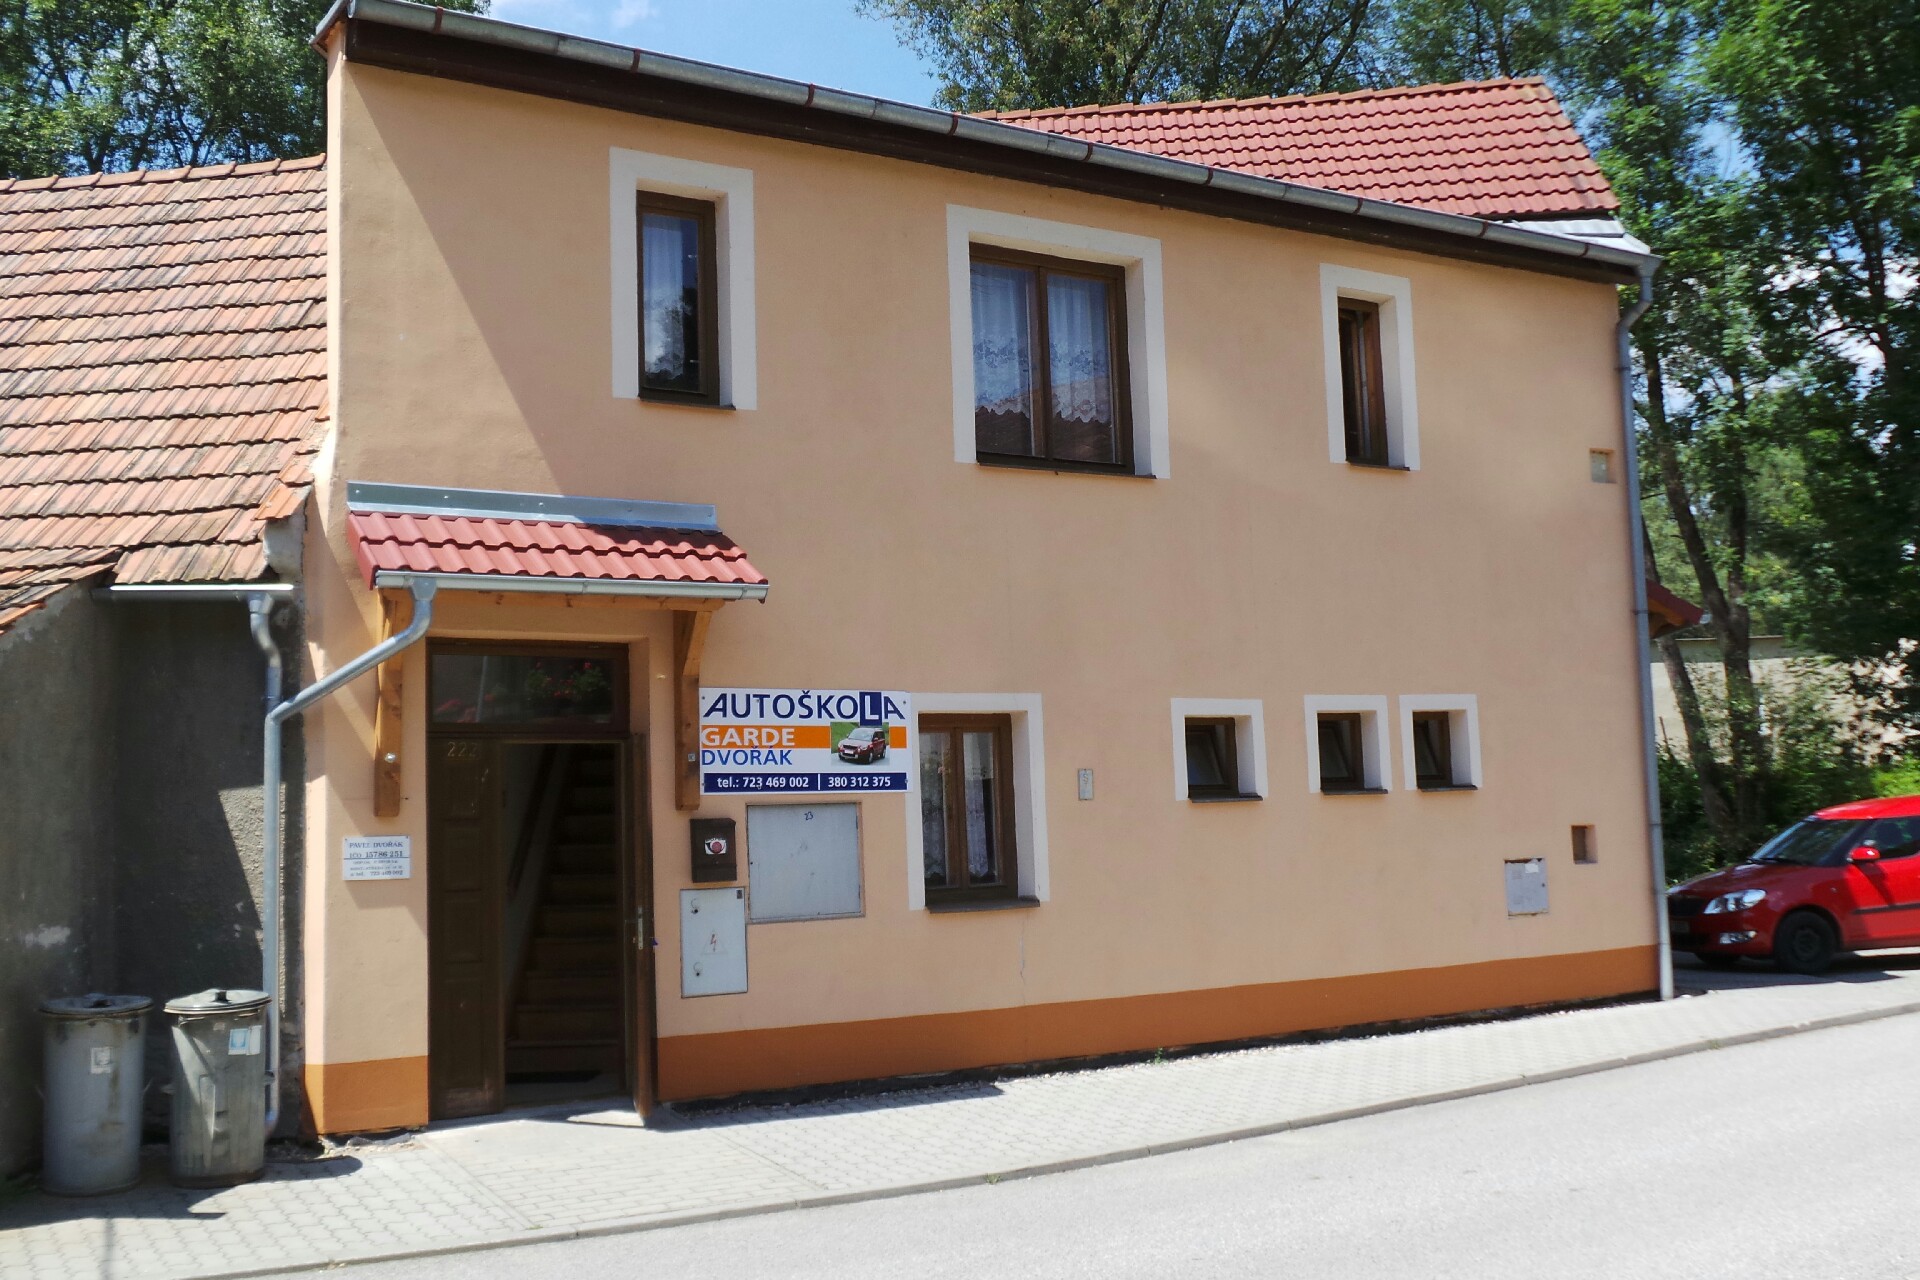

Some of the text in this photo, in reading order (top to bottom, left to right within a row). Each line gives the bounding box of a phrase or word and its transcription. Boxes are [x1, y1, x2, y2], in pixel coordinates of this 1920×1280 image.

[703, 690, 906, 720] AUTOŠKOLA
[701, 727, 796, 746] GARDE
[701, 746, 793, 766] DVOŘÁK
[717, 776, 891, 788] tel.: 723 469 002 380 312 375
